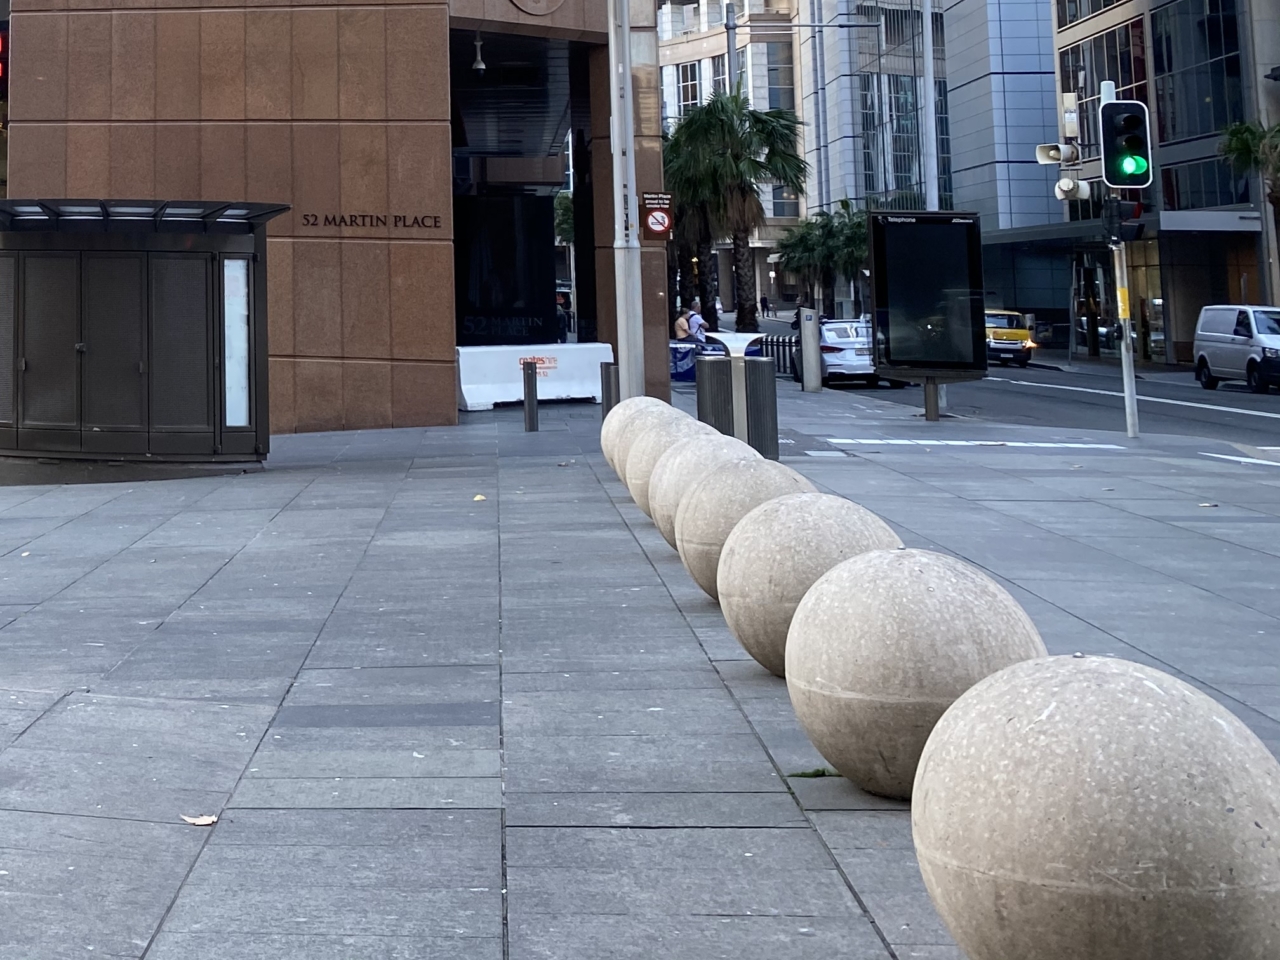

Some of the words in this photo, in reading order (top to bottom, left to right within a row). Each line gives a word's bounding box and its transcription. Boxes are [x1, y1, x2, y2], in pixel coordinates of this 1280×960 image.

[302, 214, 319, 227] 52
[323, 214, 387, 228] MARTIN
[393, 215, 442, 229] PLACE
[887, 216, 916, 224] Telephone
[462, 316, 487, 335] 52
[491, 317, 543, 327] MARTIN
[491, 327, 530, 336] PLACE
